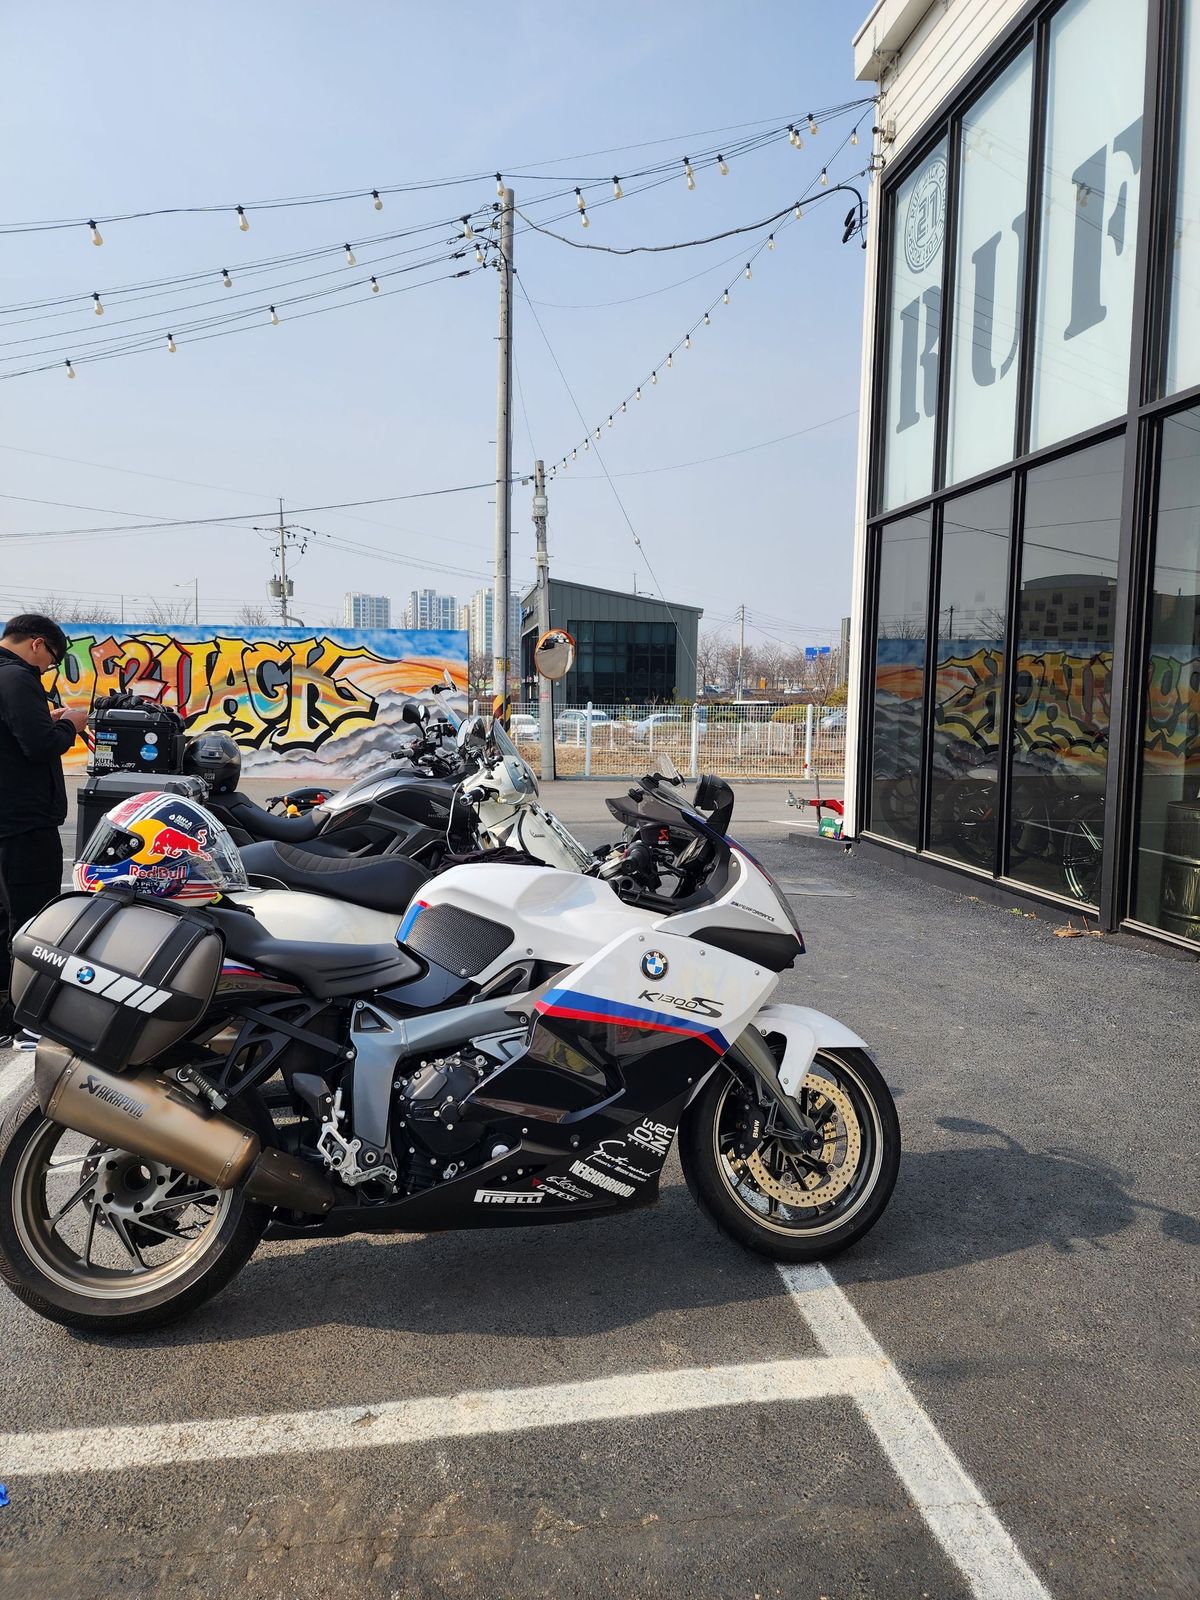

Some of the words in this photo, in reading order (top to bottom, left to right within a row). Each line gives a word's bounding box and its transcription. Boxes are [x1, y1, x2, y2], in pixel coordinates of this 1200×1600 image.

[916, 186, 939, 244] 21
[896, 114, 1143, 434] RUF
[129, 864, 157, 880] Red
[158, 865, 187, 880] Bull
[32, 945, 67, 968] BMW
[642, 1117, 675, 1139] WRC
[752, 1119, 760, 1139] BMW
[568, 1159, 636, 1198] NEIGHBORHOOD
[473, 1189, 546, 1204] PIRELLI
